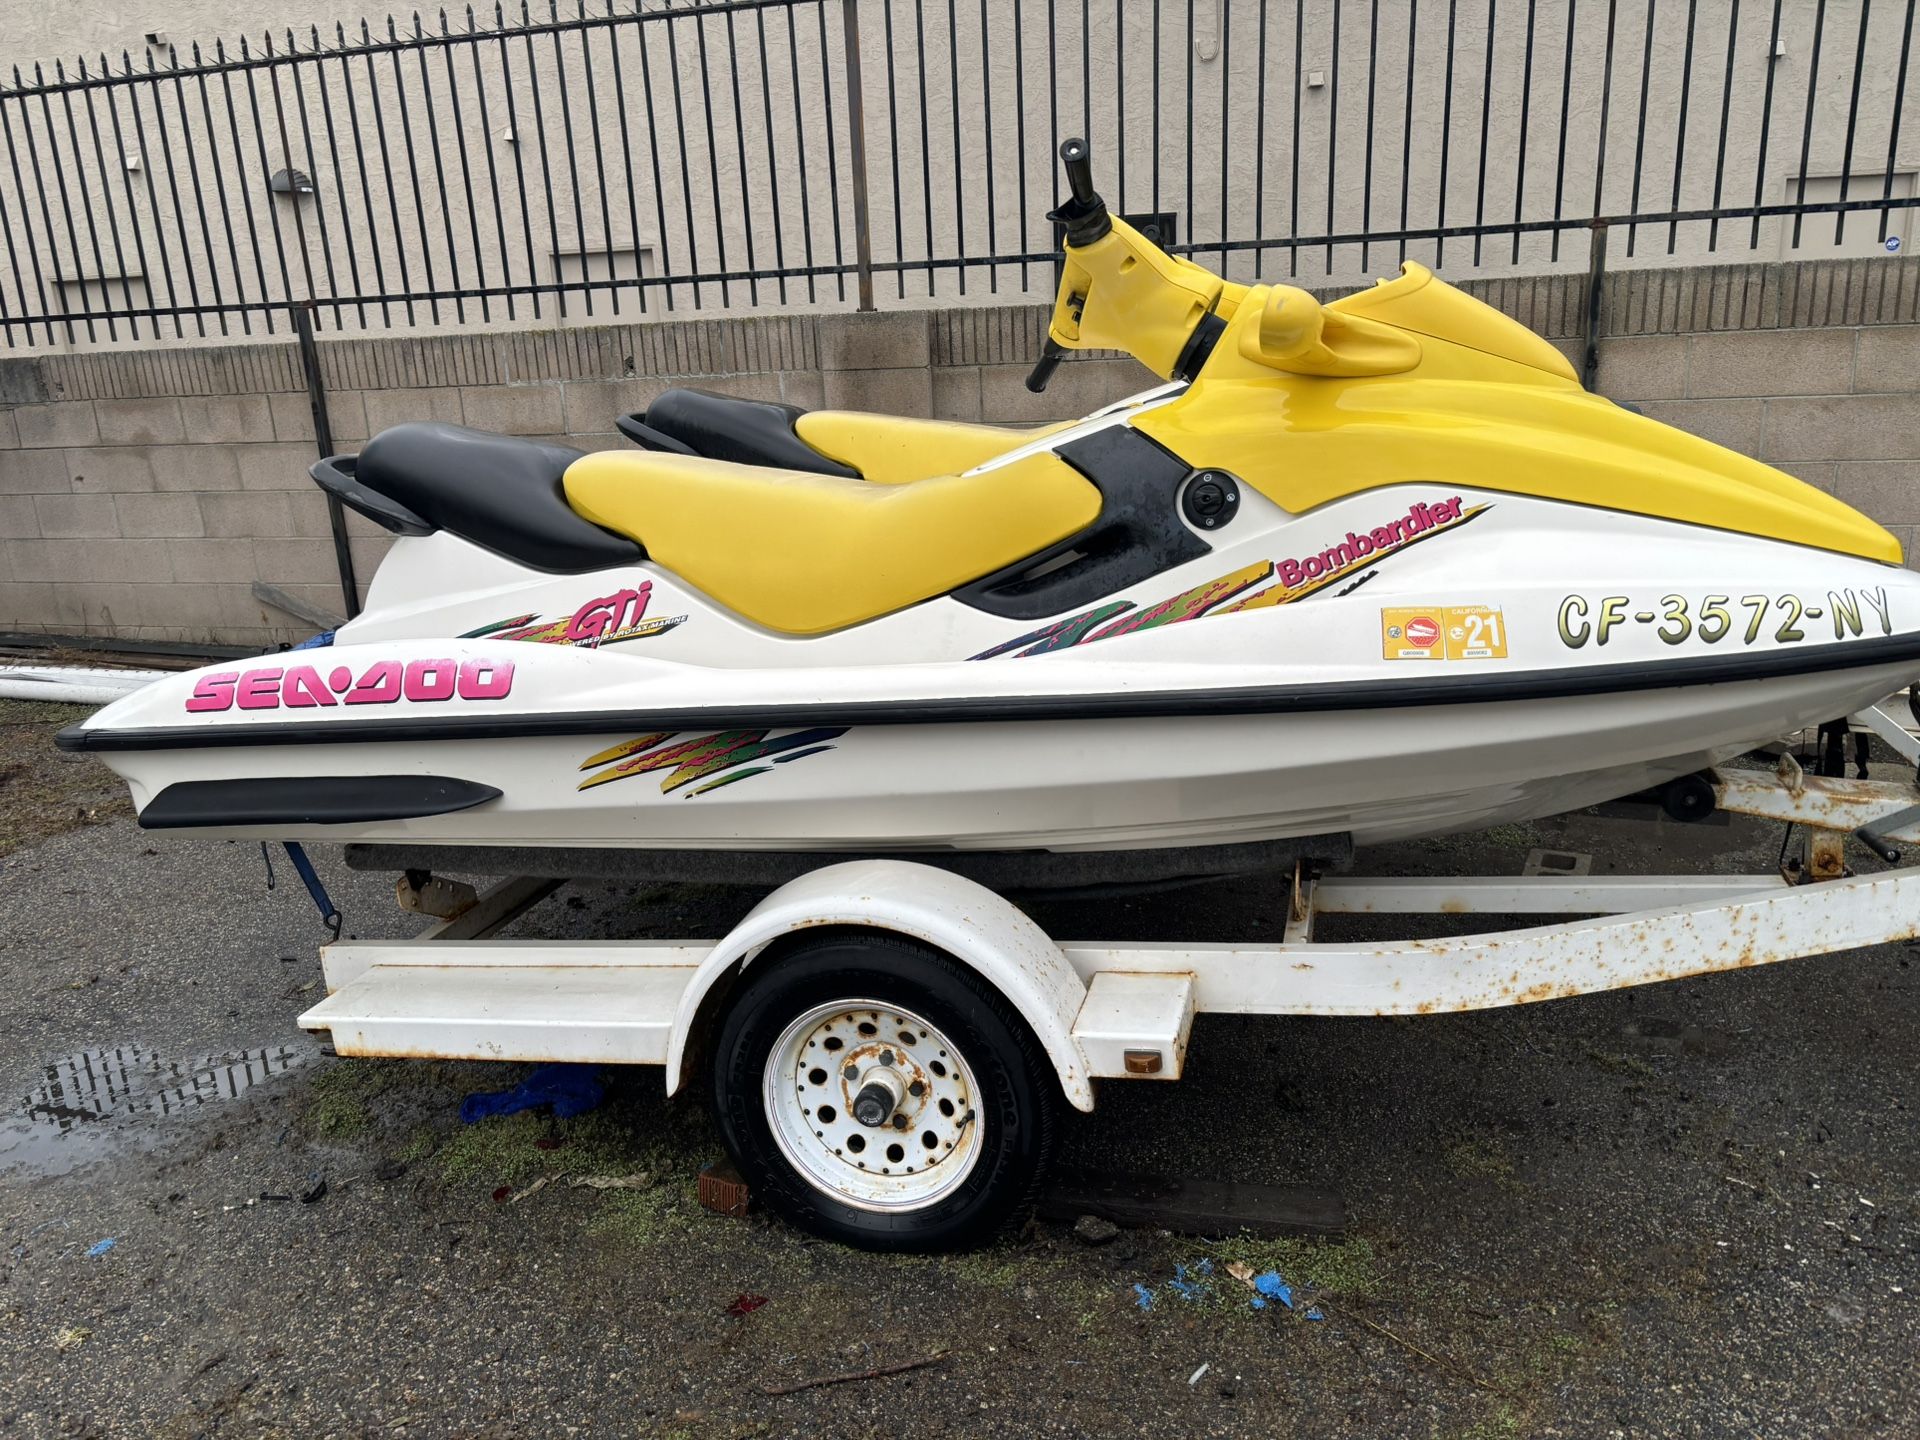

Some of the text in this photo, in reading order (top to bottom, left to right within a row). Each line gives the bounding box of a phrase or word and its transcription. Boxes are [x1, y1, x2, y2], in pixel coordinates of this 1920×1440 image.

[1276, 496, 1462, 588] Bombardier
[618, 624, 649, 637] ROTAX
[649, 614, 688, 629] MARINE
[1464, 614, 1500, 648] 21
[1558, 586, 1892, 649] CF-3572-NY
